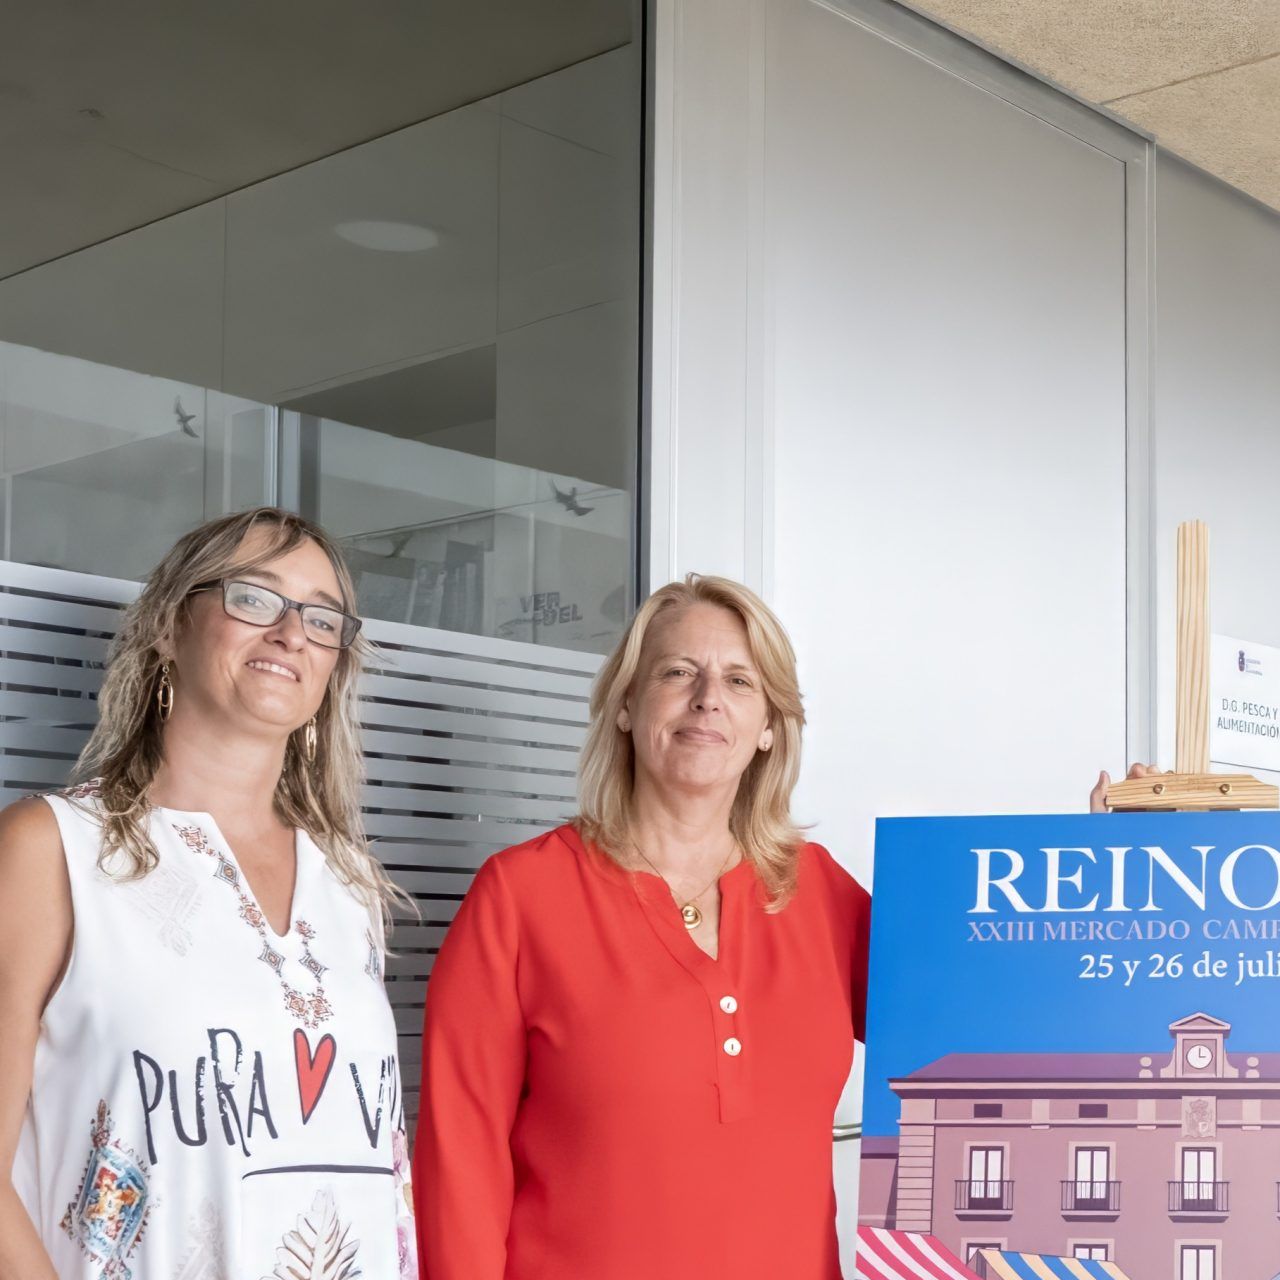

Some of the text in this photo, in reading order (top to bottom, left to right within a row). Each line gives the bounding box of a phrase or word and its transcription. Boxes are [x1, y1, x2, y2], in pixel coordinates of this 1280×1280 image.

[1242, 702, 1271, 720] PESCA
[1272, 707, 1278, 720] Y
[966, 920, 1035, 942] XXIII
[1043, 919, 1191, 941] MERCADO
[1079, 954, 1114, 979] 25
[1122, 959, 1142, 987] y
[1148, 953, 1183, 979] 26
[1192, 952, 1228, 978] de
[132, 1027, 279, 1165] PURA
